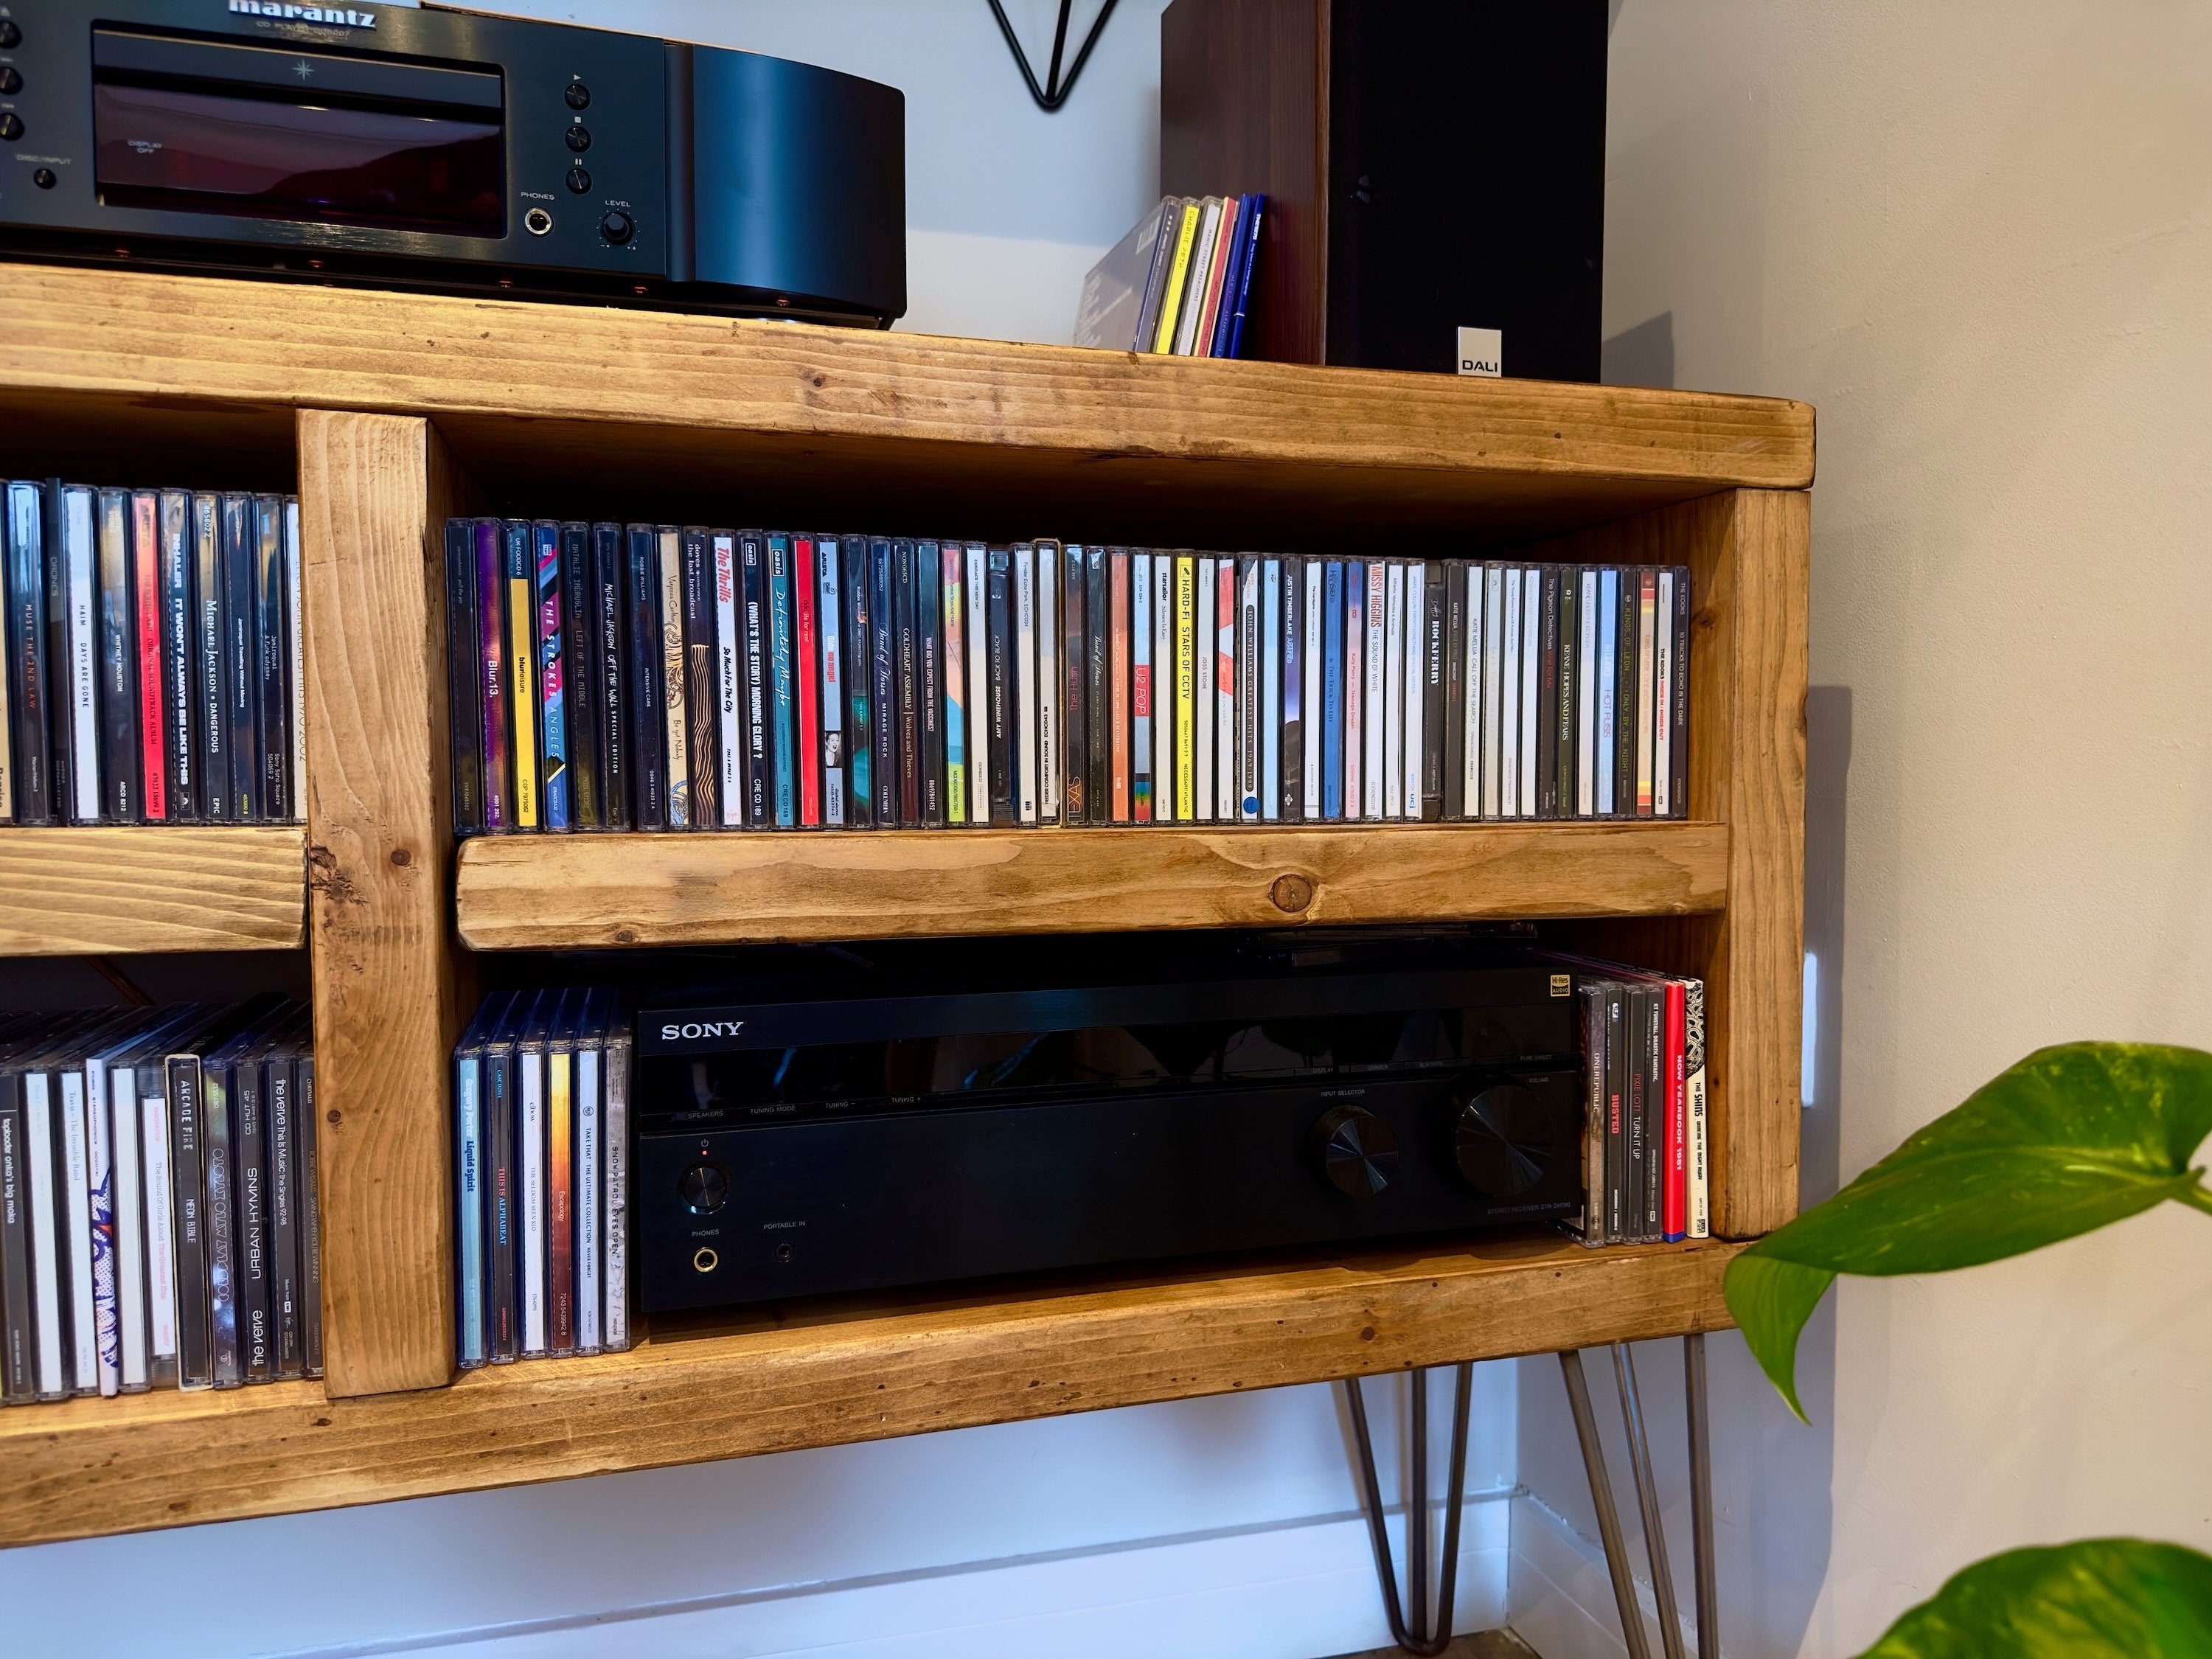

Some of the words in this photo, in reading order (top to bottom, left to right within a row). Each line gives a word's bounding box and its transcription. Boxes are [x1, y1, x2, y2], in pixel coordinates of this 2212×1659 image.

[229, 0, 375, 27] marantz
[521, 192, 554, 201] PHONES
[1203, 229, 1212, 247] MANIC
[1200, 250, 1208, 269] STREET
[1194, 271, 1204, 302] PREACHERS
[1462, 360, 1498, 372] DALI
[173, 534, 182, 588] INHALER
[717, 548, 730, 567] The
[773, 551, 783, 575] oasis
[49, 557, 58, 596] DRONES
[718, 570, 731, 602] Thrills
[1371, 566, 1382, 591] MISSY
[175, 598, 184, 607] IT
[605, 584, 615, 618] MICHAEL
[689, 578, 697, 619] broadcast
[1182, 580, 1190, 619] HARD-Fi
[1371, 595, 1381, 627] HIGGINS
[25, 605, 33, 630] MUSE
[206, 600, 218, 647] MICHAEL
[546, 602, 554, 625] THE
[748, 602, 759, 636] (WHAT'S
[775, 591, 788, 662] Definitely
[175, 610, 185, 653] WON'T
[605, 620, 616, 648] JACKSON
[878, 623, 888, 650] Band
[1182, 627, 1190, 657] STARS
[26, 637, 34, 655] THE
[114, 635, 122, 661] WHITNEY
[146, 638, 154, 670] ORIGINAL
[270, 636, 278, 669] Jamiroquai
[749, 639, 760, 653] THE
[877, 653, 888, 662] of
[902, 628, 911, 672] GOLDHEART
[1430, 621, 1440, 686] ROCKFERRY
[206, 649, 218, 692] JACKSON
[546, 635, 557, 697] STROKES
[724, 656, 732, 674] Much
[749, 655, 761, 685] STORY)
[1135, 668, 1146, 683] U2
[1182, 660, 1190, 672] OF
[177, 655, 187, 706] ALWAYS
[608, 672, 616, 686] THE
[776, 666, 788, 706] Maybe
[879, 663, 891, 697] Horses
[903, 675, 912, 709] ASSEMBLY
[1182, 675, 1190, 699] CCTV
[28, 687, 36, 709] LAW
[147, 672, 156, 719] SOUNDTRACK
[609, 689, 617, 708] WALL
[724, 700, 733, 713] City
[751, 687, 762, 723] MORNING
[1136, 688, 1147, 714] POP
[178, 709, 187, 725] BE
[209, 703, 219, 753] DANGEROUS
[1603, 712, 1611, 738] FUSS
[179, 726, 188, 754] LIKE
[550, 707, 560, 757] ANGLES
[751, 726, 762, 751] GLORY
[180, 755, 189, 785] THIS
[1552, 976, 1568, 984] Hi-Res
[661, 1022, 744, 1040] SONY
[181, 1080, 192, 1123] ARCADE
[688, 1110, 723, 1119] SPEAKERS
[750, 1106, 773, 1114] TUNING
[825, 1101, 848, 1109] TUNING
[1611, 1095, 1620, 1134] BUSTED
[183, 1127, 192, 1150] FIRE
[1632, 1116, 1641, 1138] TURN
[465, 1141, 475, 1166] Liquid
[1633, 1149, 1641, 1159] UP
[466, 1169, 476, 1192] Spirit
[248, 1168, 260, 1222] HYMNS
[557, 1191, 566, 1221] Escapology
[186, 1199, 195, 1219] NEON
[187, 1222, 196, 1243] BIBLE
[692, 1228, 720, 1237] PHONES
[764, 1222, 797, 1231] PORTABLE
[250, 1228, 261, 1279] URBAN
[252, 1311, 263, 1343] verve
[252, 1346, 264, 1366] the
